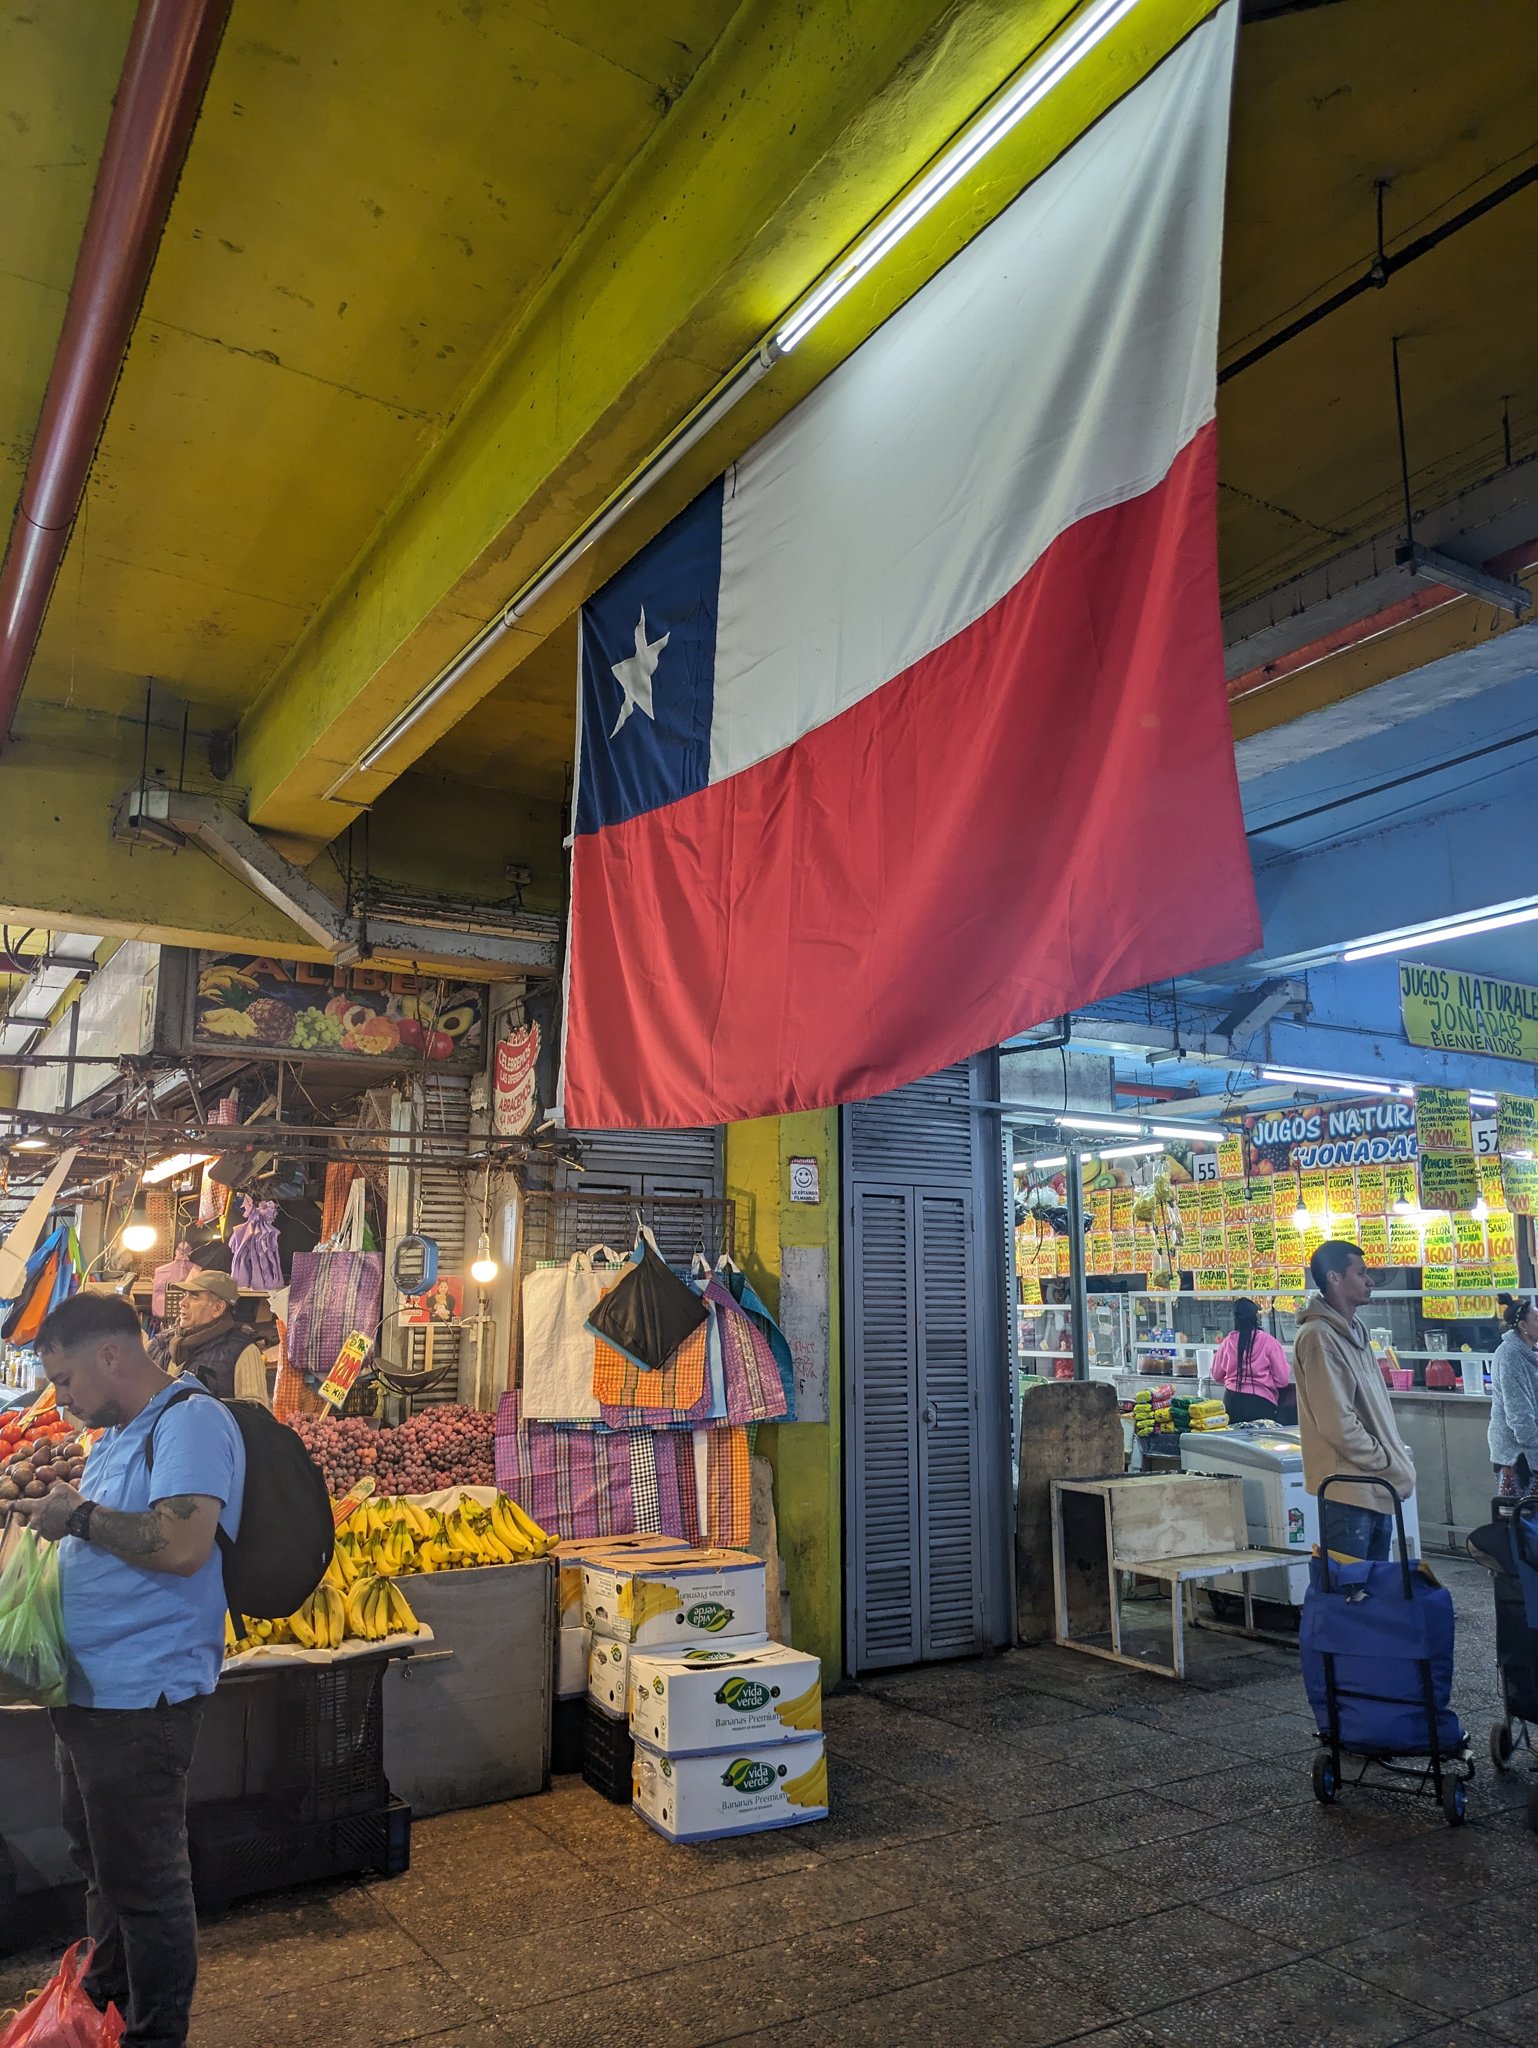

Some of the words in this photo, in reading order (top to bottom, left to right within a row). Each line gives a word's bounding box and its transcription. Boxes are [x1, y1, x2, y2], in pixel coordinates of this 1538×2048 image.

[1401, 967, 1449, 1000] JUGOS
[1459, 976, 1538, 1021] NATURALE
[1431, 1031, 1522, 1056] BIENVENIDOS
[498, 1079, 531, 1112] ABRACEMOS
[1253, 1116, 1321, 1146] JUGOS
[1198, 1162, 1216, 1181] 55
[1424, 1246, 1452, 1264] 1600
[1455, 1242, 1485, 1260] 1600
[1488, 1236, 1514, 1258] 1600
[1196, 1270, 1227, 1280] PLATANO
[1281, 1278, 1302, 1287] PAPAYA
[709, 1588, 735, 1598] Bananas
[693, 1606, 717, 1616] verde
[693, 1614, 711, 1625] vida
[742, 1683, 763, 1697] vida
[736, 1695, 763, 1708] verde
[715, 1716, 747, 1728] Bananas
[748, 1712, 782, 1723] Premium
[749, 1763, 769, 1778] vida
[743, 1776, 769, 1789] verde
[722, 1799, 753, 1811] Bananas
[755, 1792, 788, 1804] Premium
